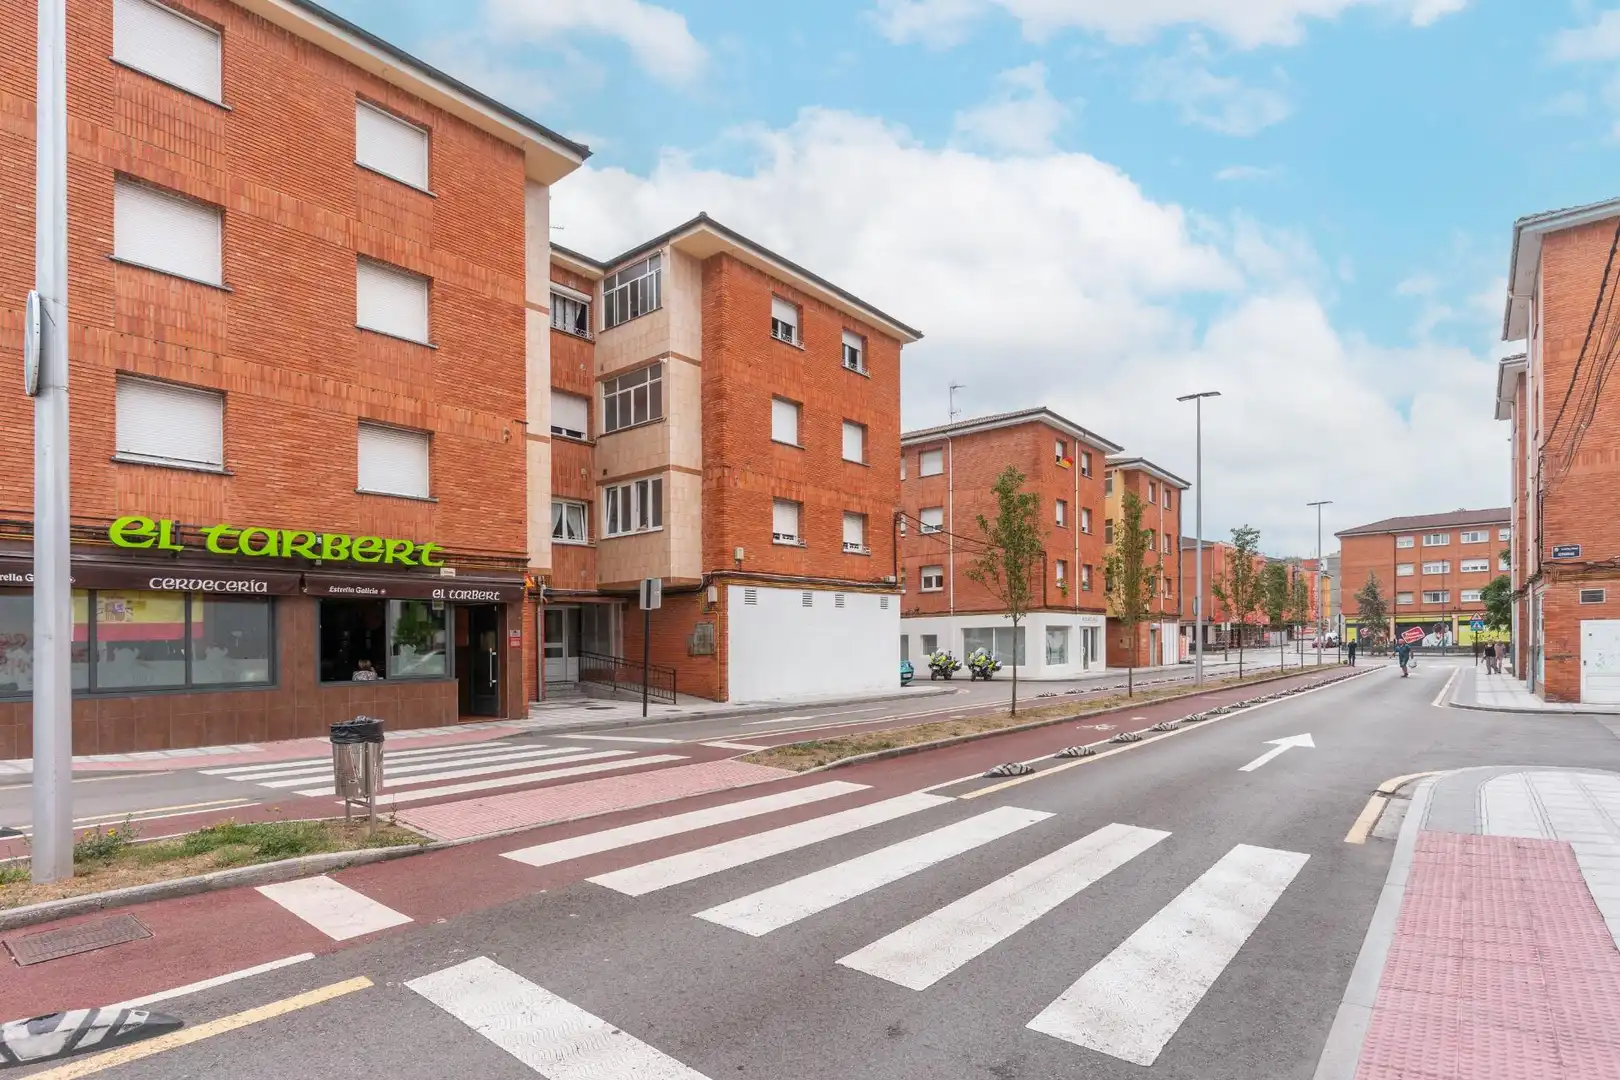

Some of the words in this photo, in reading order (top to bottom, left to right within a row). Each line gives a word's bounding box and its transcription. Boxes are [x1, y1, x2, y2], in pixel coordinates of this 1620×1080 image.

[0, 573, 23, 582] rella
[329, 585, 355, 593] Estrella
[355, 586, 379, 595] Galicia
